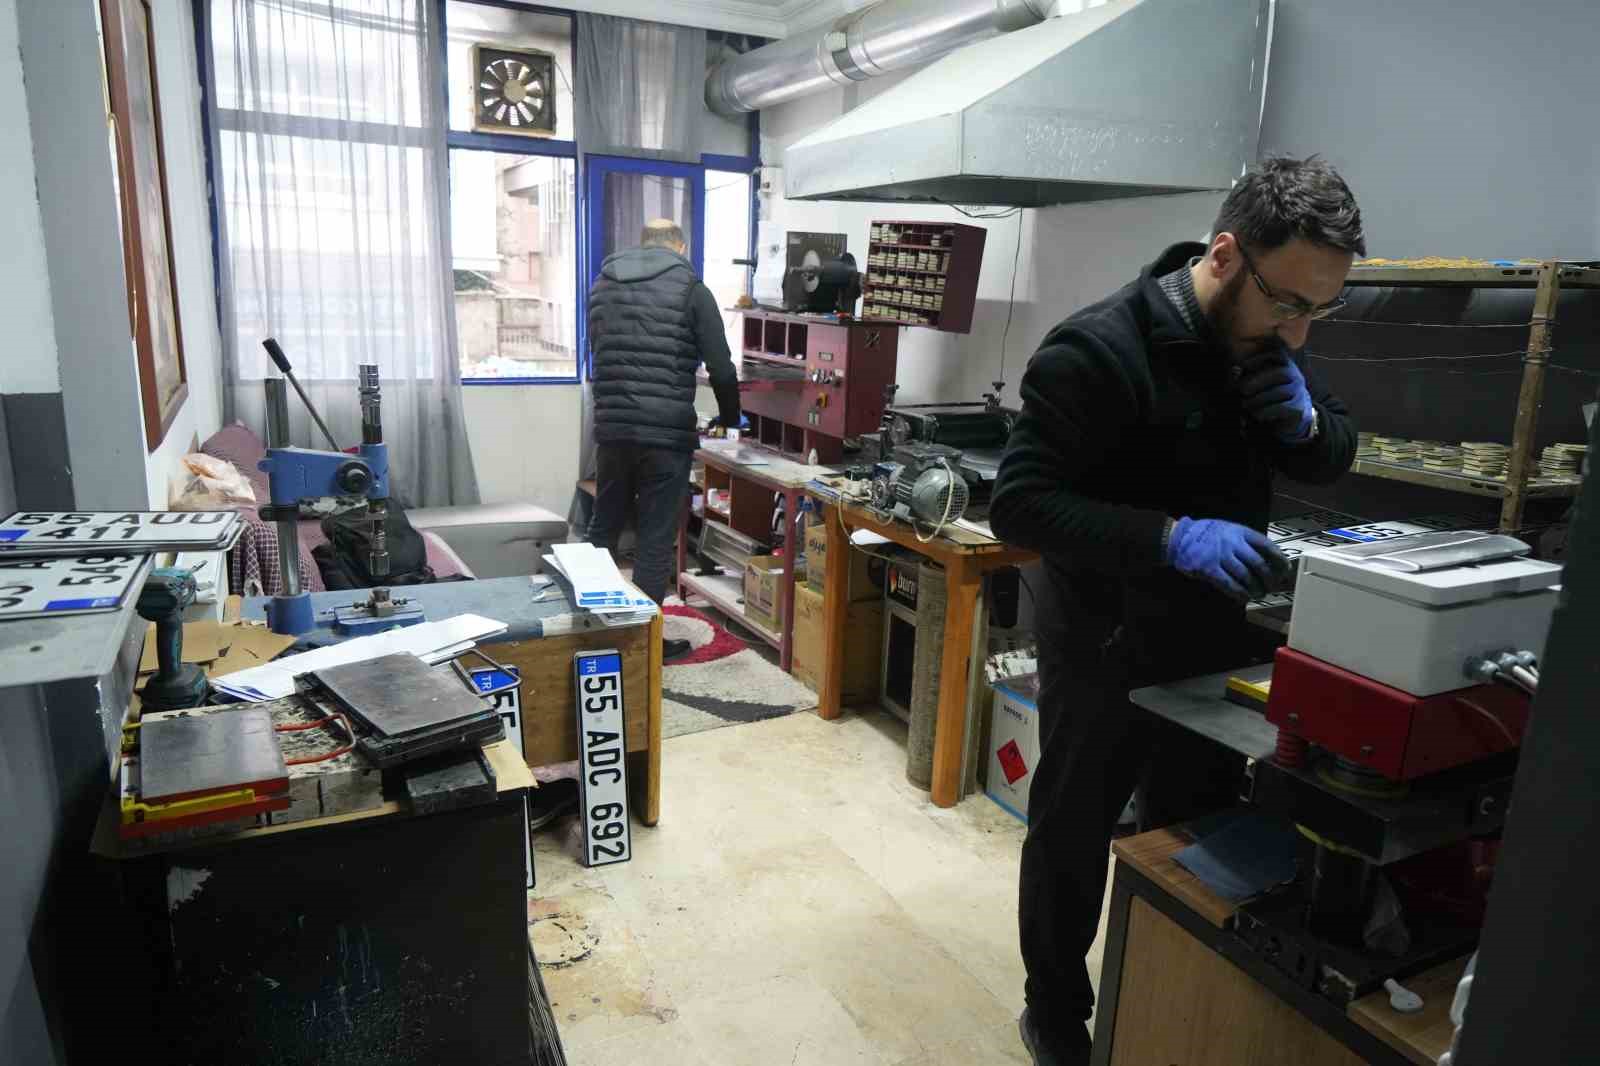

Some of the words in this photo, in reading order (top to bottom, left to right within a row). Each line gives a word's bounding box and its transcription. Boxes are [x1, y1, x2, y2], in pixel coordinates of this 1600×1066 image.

[13, 513, 95, 525] 55
[106, 513, 225, 525] AUU
[37, 526, 141, 539] 411
[1349, 525, 1403, 537] 55
[586, 658, 596, 673] TR
[480, 675, 492, 690] TR
[584, 675, 619, 714] 55
[586, 730, 622, 787] ADC
[590, 801, 626, 862] 692
